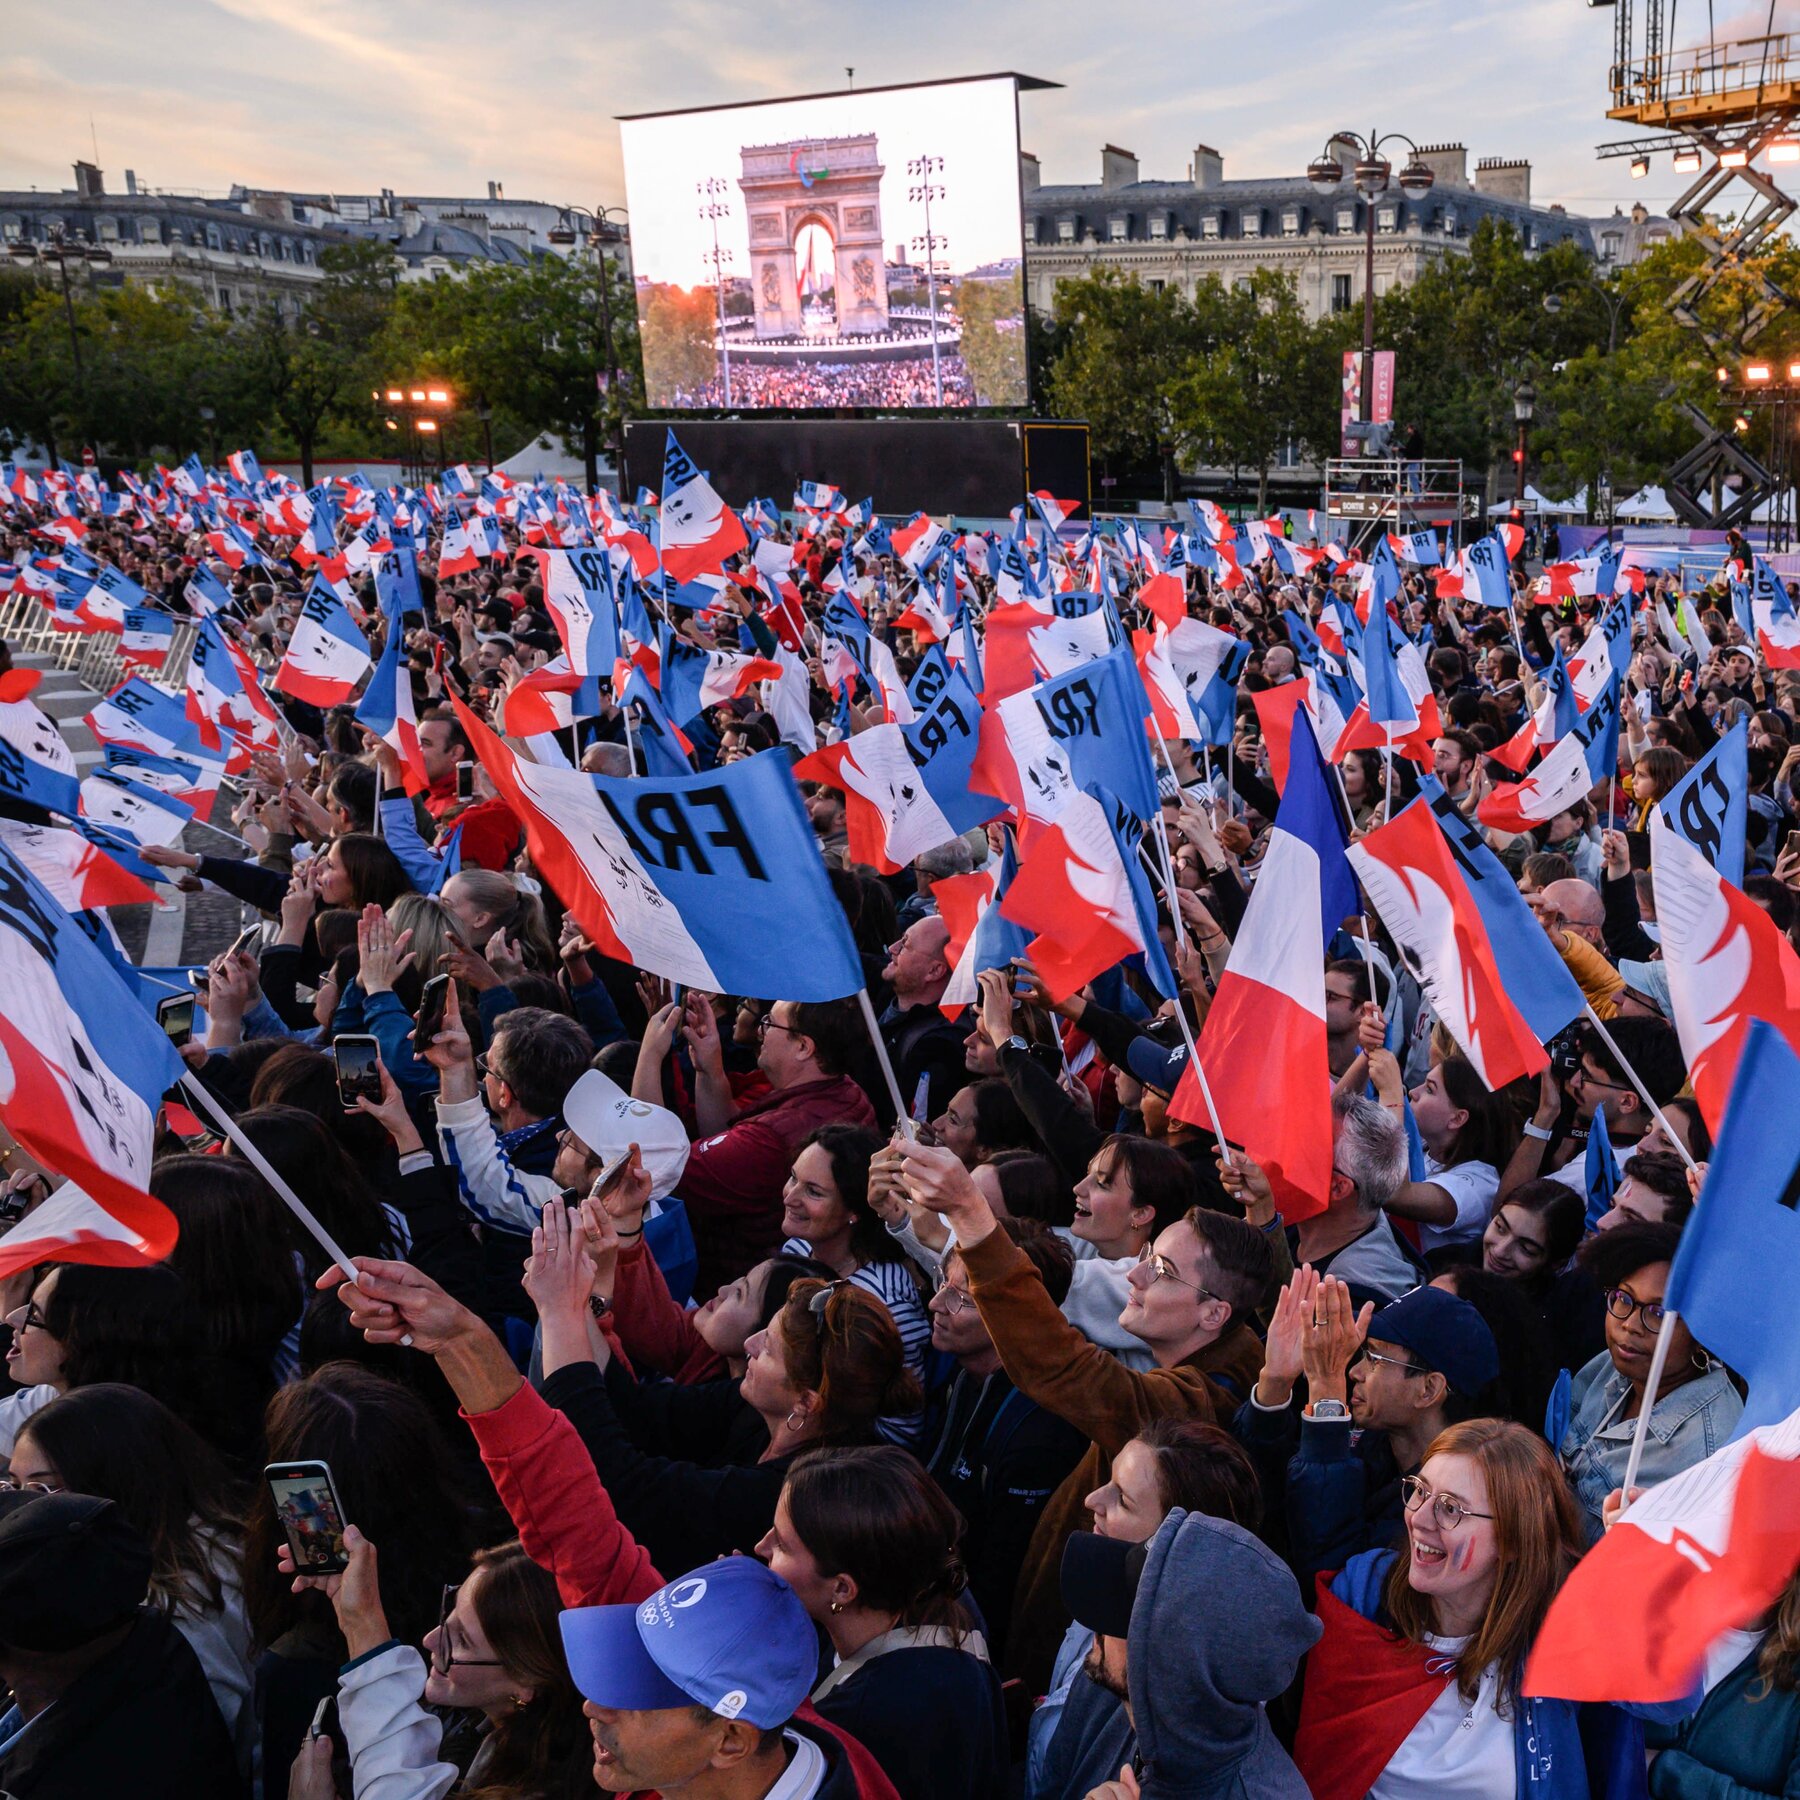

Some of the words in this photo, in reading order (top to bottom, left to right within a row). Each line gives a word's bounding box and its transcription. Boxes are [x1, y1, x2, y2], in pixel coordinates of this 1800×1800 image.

[1342, 502, 1364, 511] SORTIE
[1167, 1043, 1187, 1065] NCE
[660, 1605, 675, 1629] 2024
